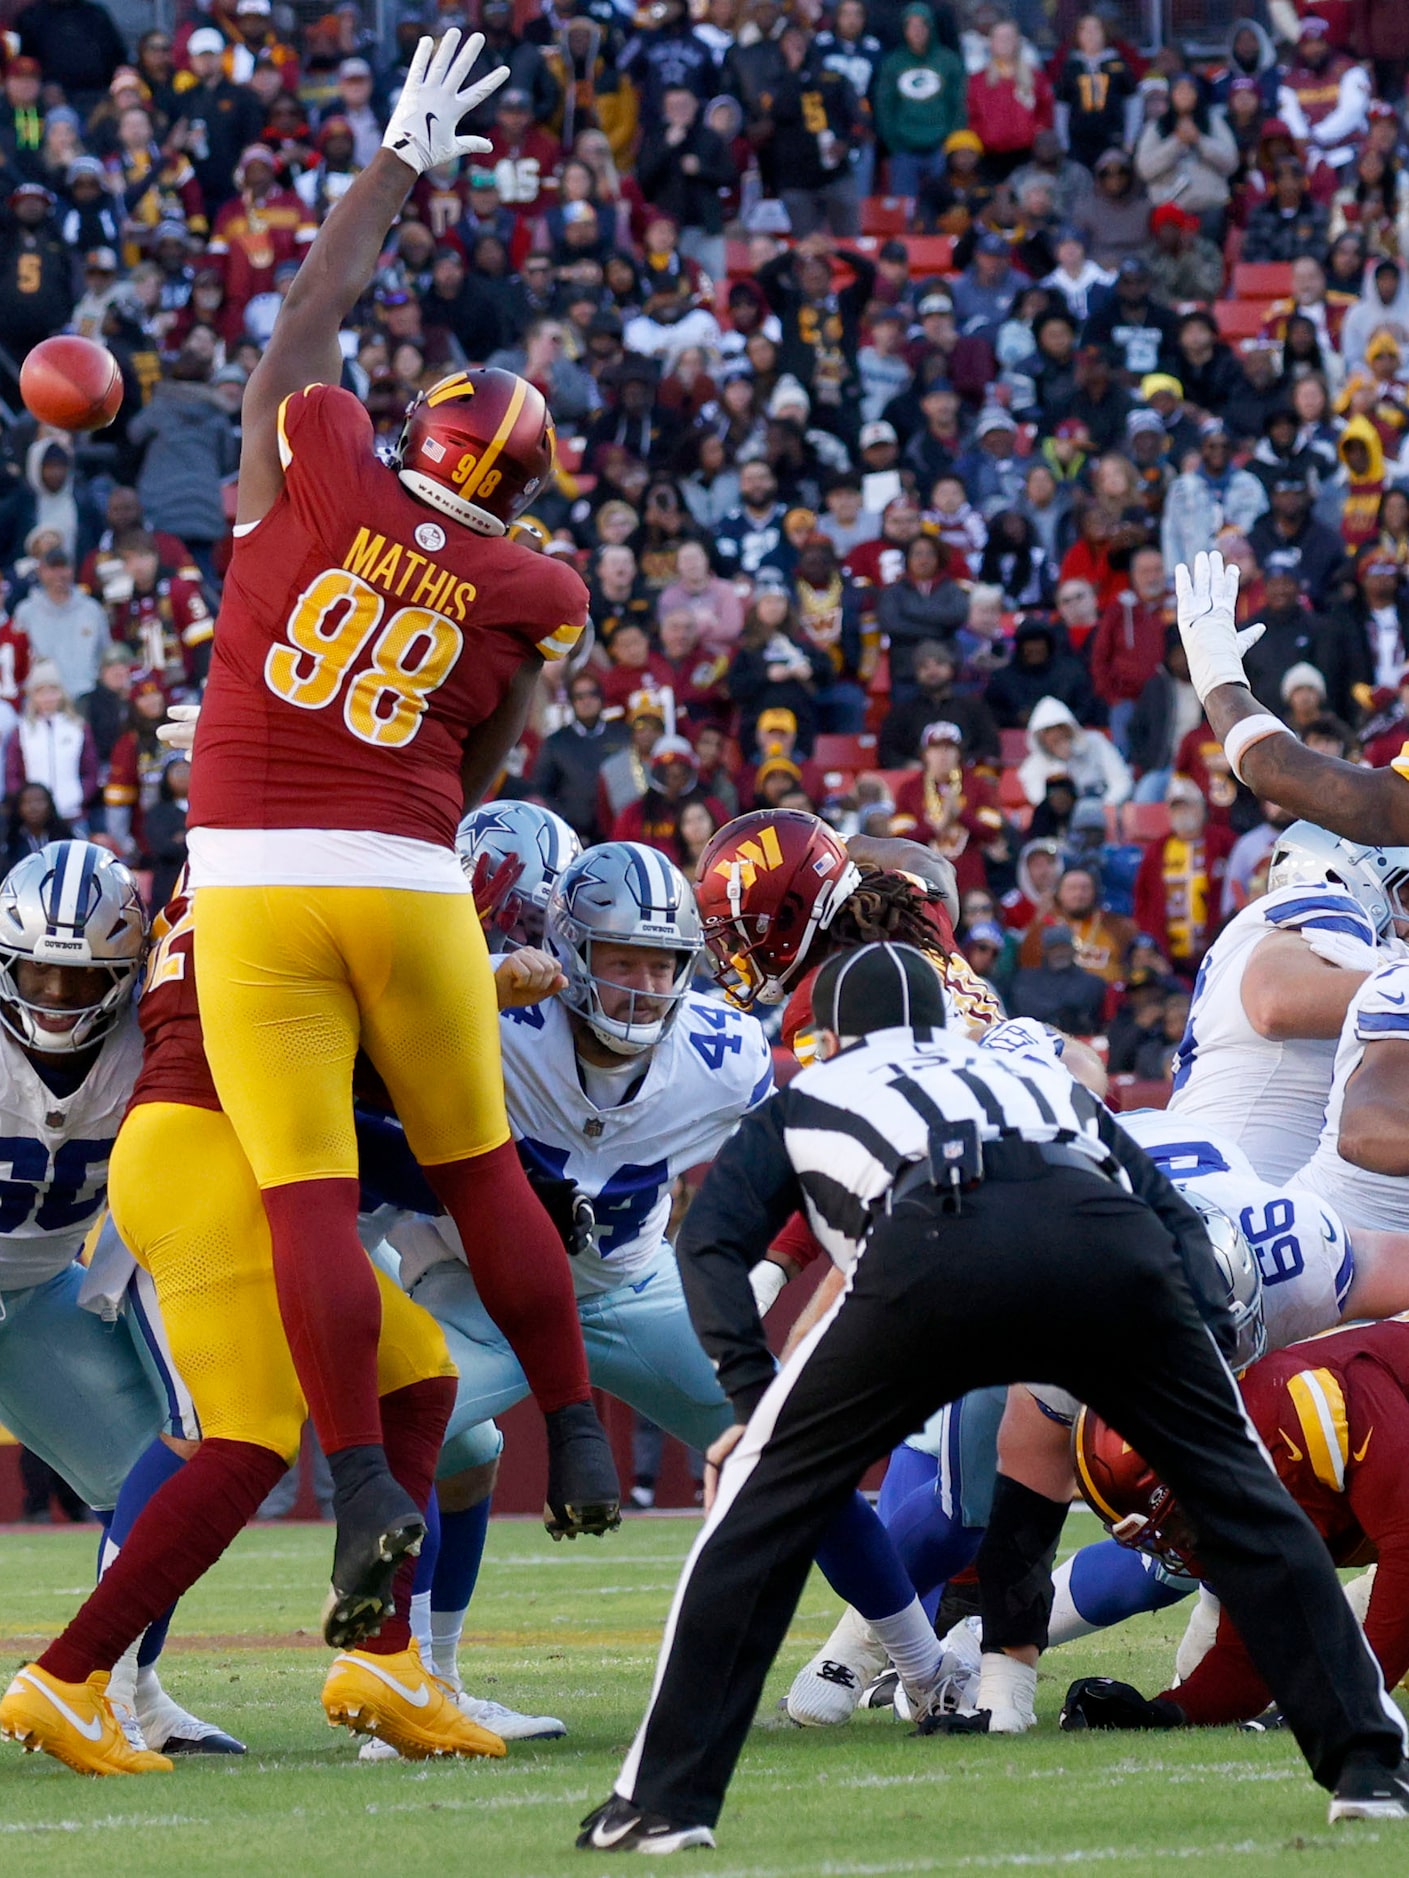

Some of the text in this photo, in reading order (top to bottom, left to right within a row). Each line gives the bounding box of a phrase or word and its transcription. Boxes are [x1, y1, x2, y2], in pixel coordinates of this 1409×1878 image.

[418, 484, 491, 530] WASHINGTON
[342, 526, 477, 621] MATHIS
[264, 568, 464, 748] 98
[44, 940, 83, 950] COWBOYS
[642, 925, 674, 934] COWBOYS
[689, 1003, 742, 1071] 44
